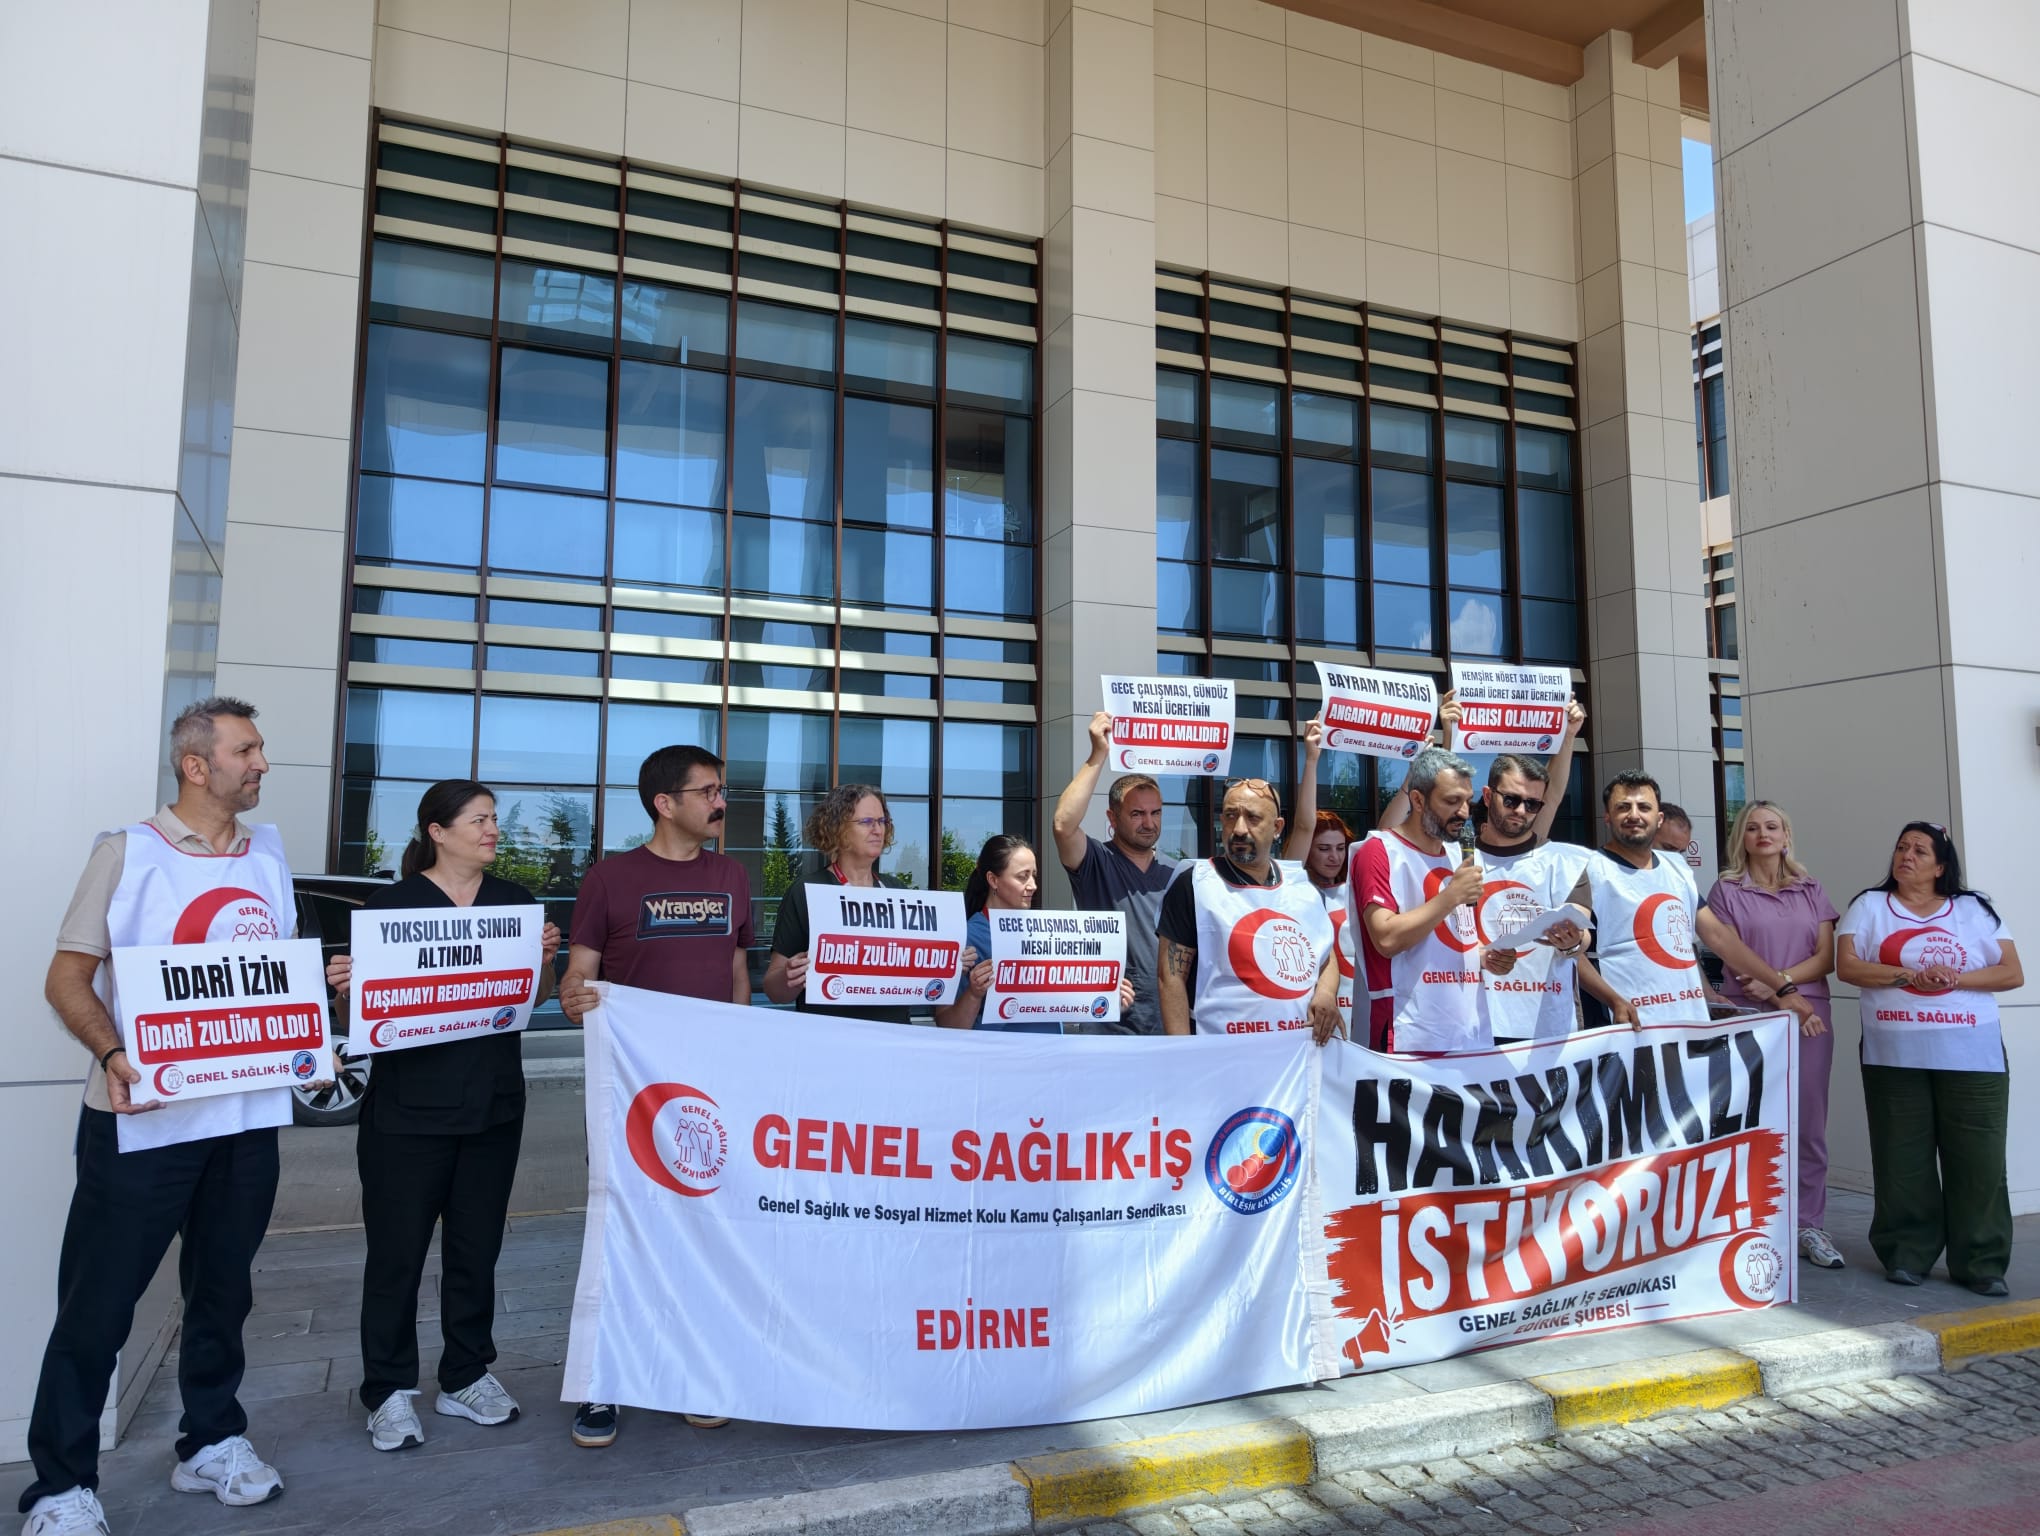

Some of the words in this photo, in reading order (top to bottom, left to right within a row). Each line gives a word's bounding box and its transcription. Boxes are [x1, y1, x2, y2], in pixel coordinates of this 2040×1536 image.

[1111, 682, 1135, 694] GECE
[1138, 683, 1191, 699] ÇALIŞMASI,
[1194, 684, 1228, 699] GÜNDÜZ
[1327, 672, 1380, 694] BAYRAM
[1382, 681, 1431, 702] MESAİSİ
[1520, 674, 1537, 684] SAAT
[1460, 686, 1486, 698] ASGARİ
[1488, 687, 1510, 700] ÜCRET
[1512, 690, 1530, 700] SAAT
[1133, 700, 1163, 714] MESAİ
[1165, 700, 1210, 717] ÜCRETİNİN
[1329, 704, 1378, 726] ANGARYA
[1380, 712, 1422, 733] OLAMAZ
[1461, 707, 1502, 726] YARISI
[1505, 709, 1553, 728] OLAMAZ
[1114, 719, 1130, 738] İKİ
[1132, 722, 1158, 740] KATI
[1161, 724, 1220, 743] OLMALIDIR
[1344, 738, 1366, 746] GENEL
[238, 906, 268, 919] GENEL
[645, 898, 724, 922] Wrangler
[840, 896, 895, 929] İDARİ
[899, 899, 938, 931] İZİN
[380, 919, 472, 944] YOKSULLUK
[477, 917, 521, 939] SINIRI
[999, 917, 1024, 932] GECE
[1026, 918, 1081, 937] ÇALIŞMASI,
[1084, 916, 1119, 934] GÜNDÜZ
[418, 945, 482, 969] ALTINDA
[819, 939, 859, 965] İDARİ
[862, 942, 911, 967] ZULÜM
[914, 948, 948, 969] OLDU
[1021, 938, 1052, 955] MESAİ
[1055, 938, 1101, 955] ÜCRETİNİN
[160, 956, 234, 1001] İDARİ
[238, 955, 289, 996] İZİN
[998, 962, 1016, 985] İKİ
[1019, 966, 1046, 985] KATI
[1048, 966, 1111, 984] OLMALIDIR
[1423, 971, 1458, 984] GENEL
[1460, 969, 1484, 984] SAĞLI
[364, 986, 433, 1013] YAŞAMAYI
[438, 978, 523, 1002] REDDEDİYORUZ
[846, 986, 877, 994] GENEL
[880, 986, 923, 997] SAĞLIK-İŞ
[1494, 980, 1562, 995] SAĞLIK-İŞ
[1049, 1004, 1089, 1014] SAĞLIK-İŞ
[1631, 992, 1677, 1007] GENEL
[398, 1026, 435, 1038] GENEL
[439, 1018, 490, 1032] SAĞLIK-İŞ
[1226, 1021, 1274, 1034] GENEL
[1876, 1010, 1913, 1022] GENEL
[1917, 1010, 1976, 1028] SAĞLIK-İŞ
[140, 1017, 193, 1052] İDARİ
[198, 1014, 262, 1047] ZULÜM
[266, 1014, 309, 1040] OLDU
[187, 1072, 228, 1084] GENEL
[232, 1063, 290, 1076] SAĞLIK-İŞ
[1353, 1030, 1764, 1196] HAKKIMIZI
[682, 1106, 712, 1120] GENEL
[712, 1119, 727, 1155] SAĞLIK
[753, 1114, 933, 1179] GENEL
[950, 1117, 1192, 1191] SAĞLIK-İŞ
[758, 1196, 800, 1215] Genel
[805, 1200, 849, 1220] Sağlık
[854, 1208, 870, 1219] ve
[874, 1205, 920, 1224] Sosyal
[924, 1207, 972, 1223] Hizmet
[976, 1208, 1006, 1224] Kolu
[1010, 1208, 1049, 1223] Kamu
[1052, 1207, 1123, 1226] Çalışanları
[1126, 1204, 1186, 1220] Sendikası
[1380, 1142, 1752, 1315] İSTİYORUZ!
[1459, 1310, 1517, 1332] GENEL
[1522, 1296, 1578, 1321] SAĞLIK
[1580, 1291, 1596, 1306] İŞ
[1597, 1275, 1676, 1301] SENDİKASI
[916, 1298, 1050, 1350] EDİRNE
[1514, 1313, 1570, 1335] EDİRNE
[1574, 1300, 1630, 1327] ŞUBESİ
